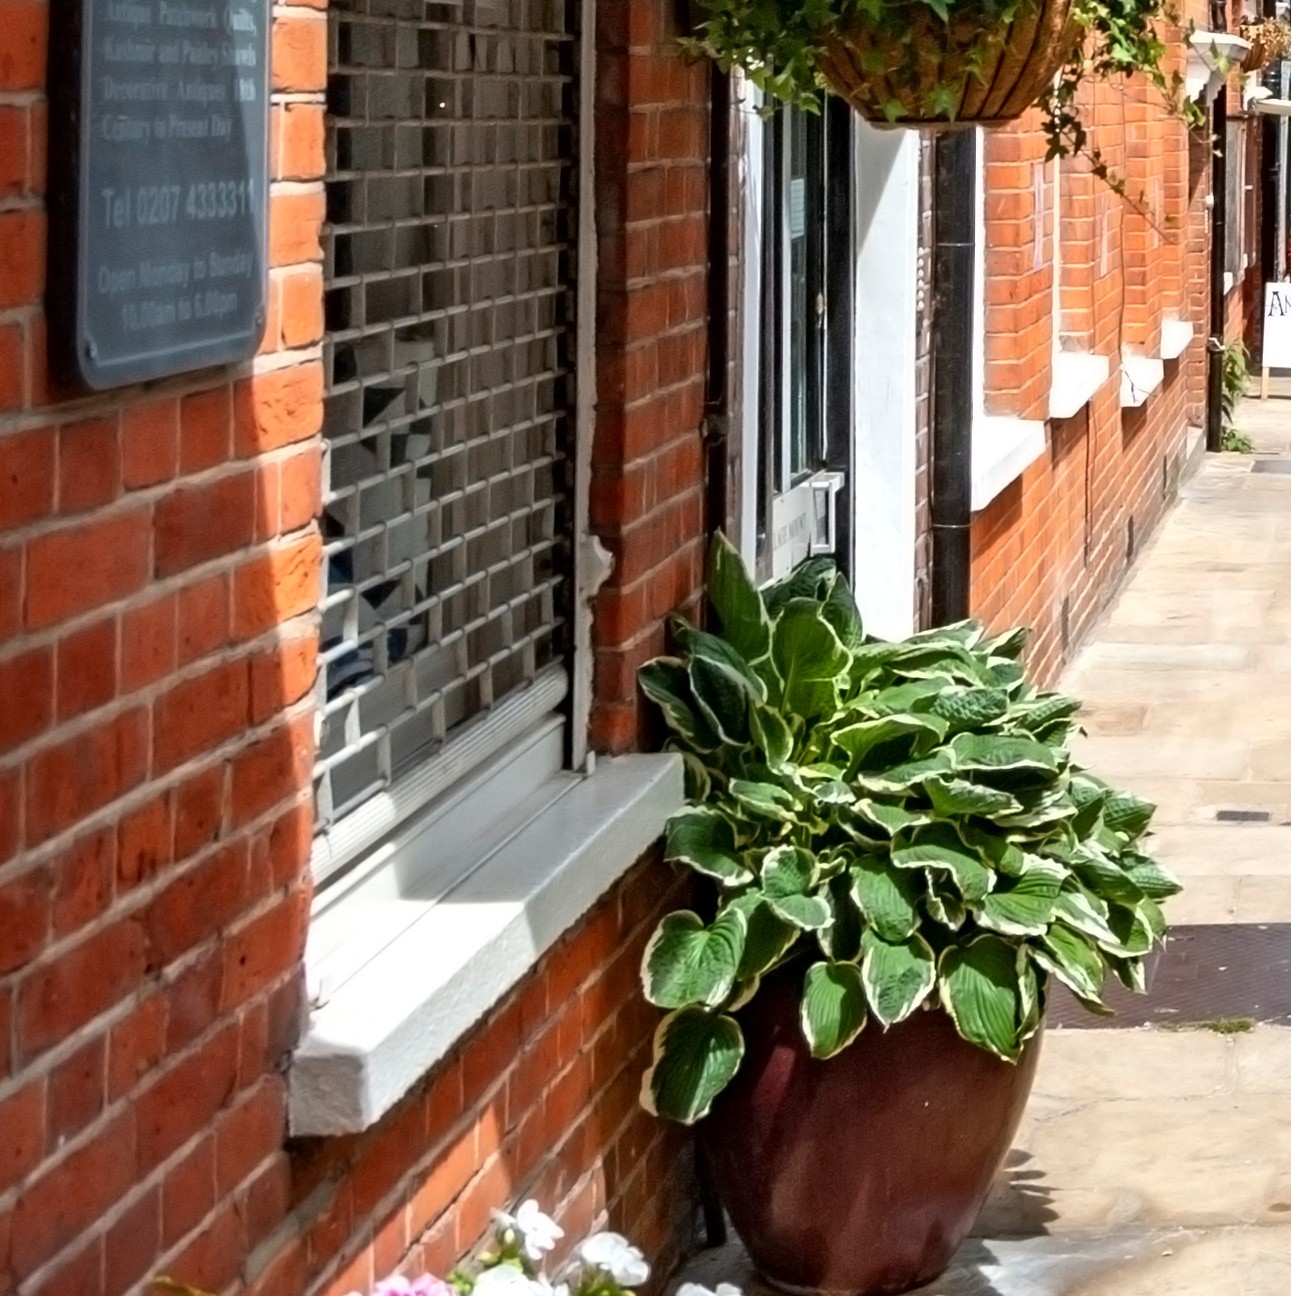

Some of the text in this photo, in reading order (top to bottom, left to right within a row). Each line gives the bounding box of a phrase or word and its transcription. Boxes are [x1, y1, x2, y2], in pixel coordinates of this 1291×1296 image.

[102, 178, 255, 229] Tel 0207 4333311
[99, 265, 136, 296] Open
[138, 260, 192, 290] Monday
[209, 250, 253, 279] Sunday
